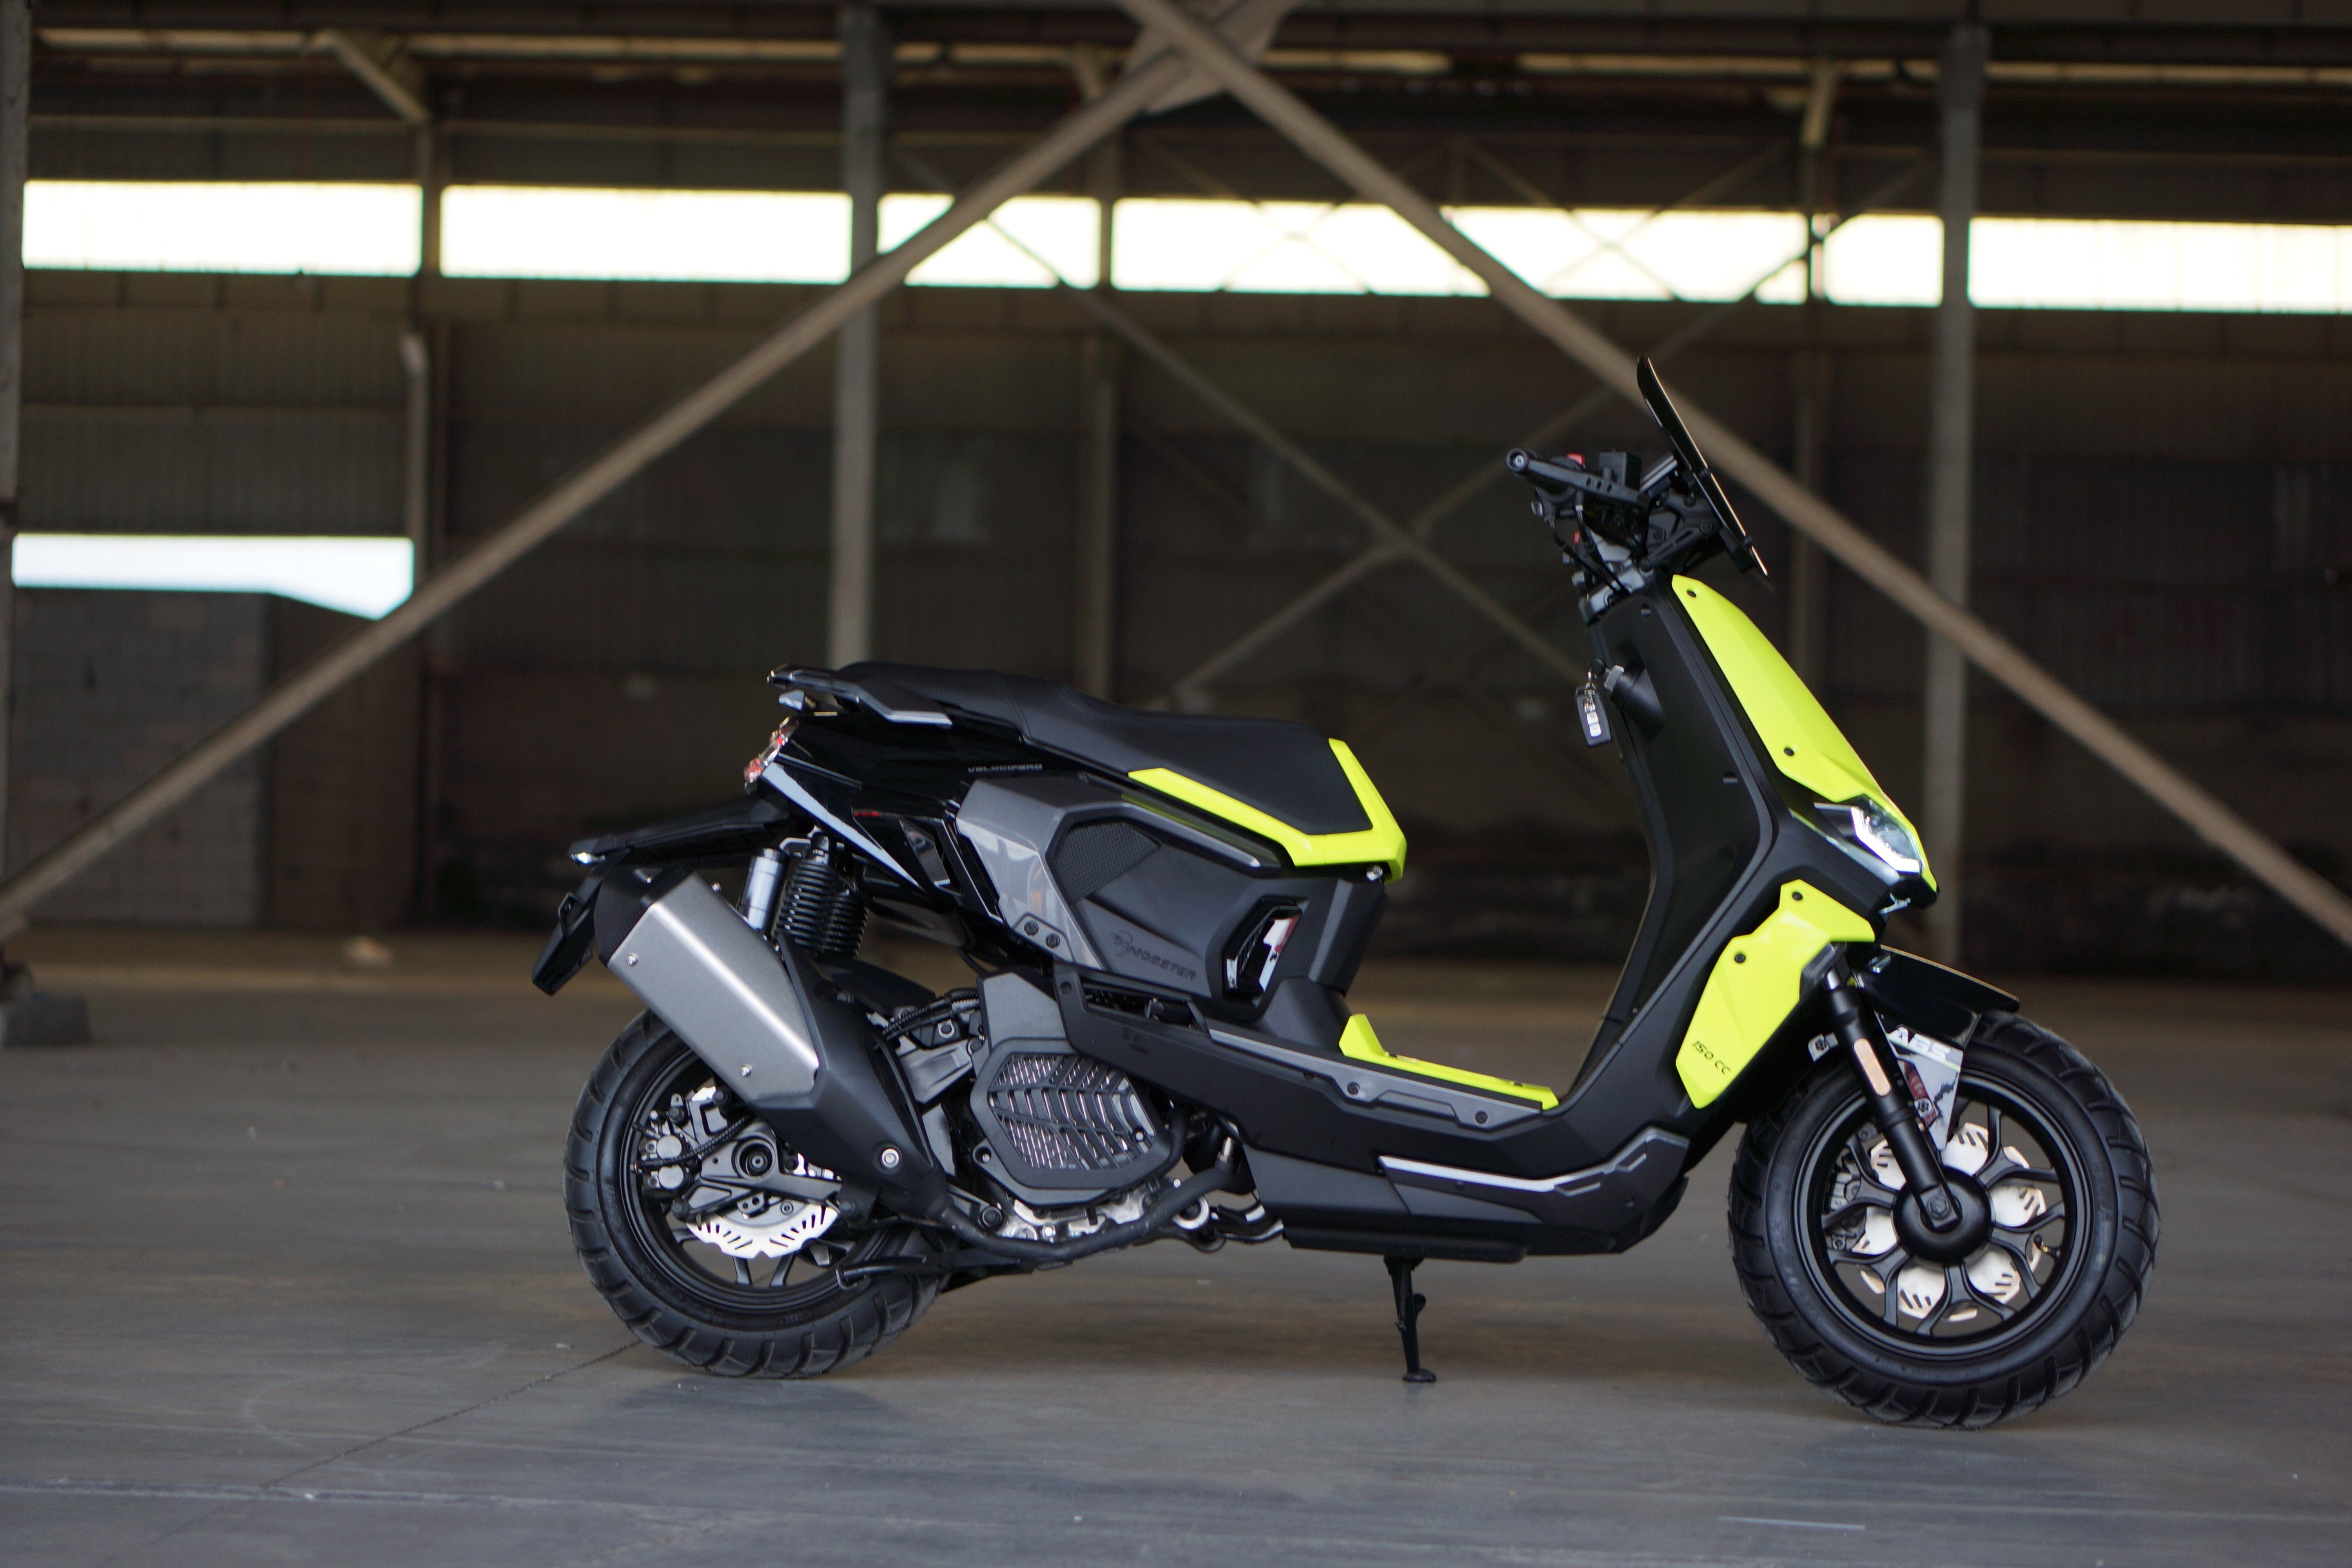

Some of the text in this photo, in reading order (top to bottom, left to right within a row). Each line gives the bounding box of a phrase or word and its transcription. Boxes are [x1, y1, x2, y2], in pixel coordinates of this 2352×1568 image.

[1692, 1041, 1731, 1075] 150 CC
[1886, 1026, 1948, 1062] ABS
